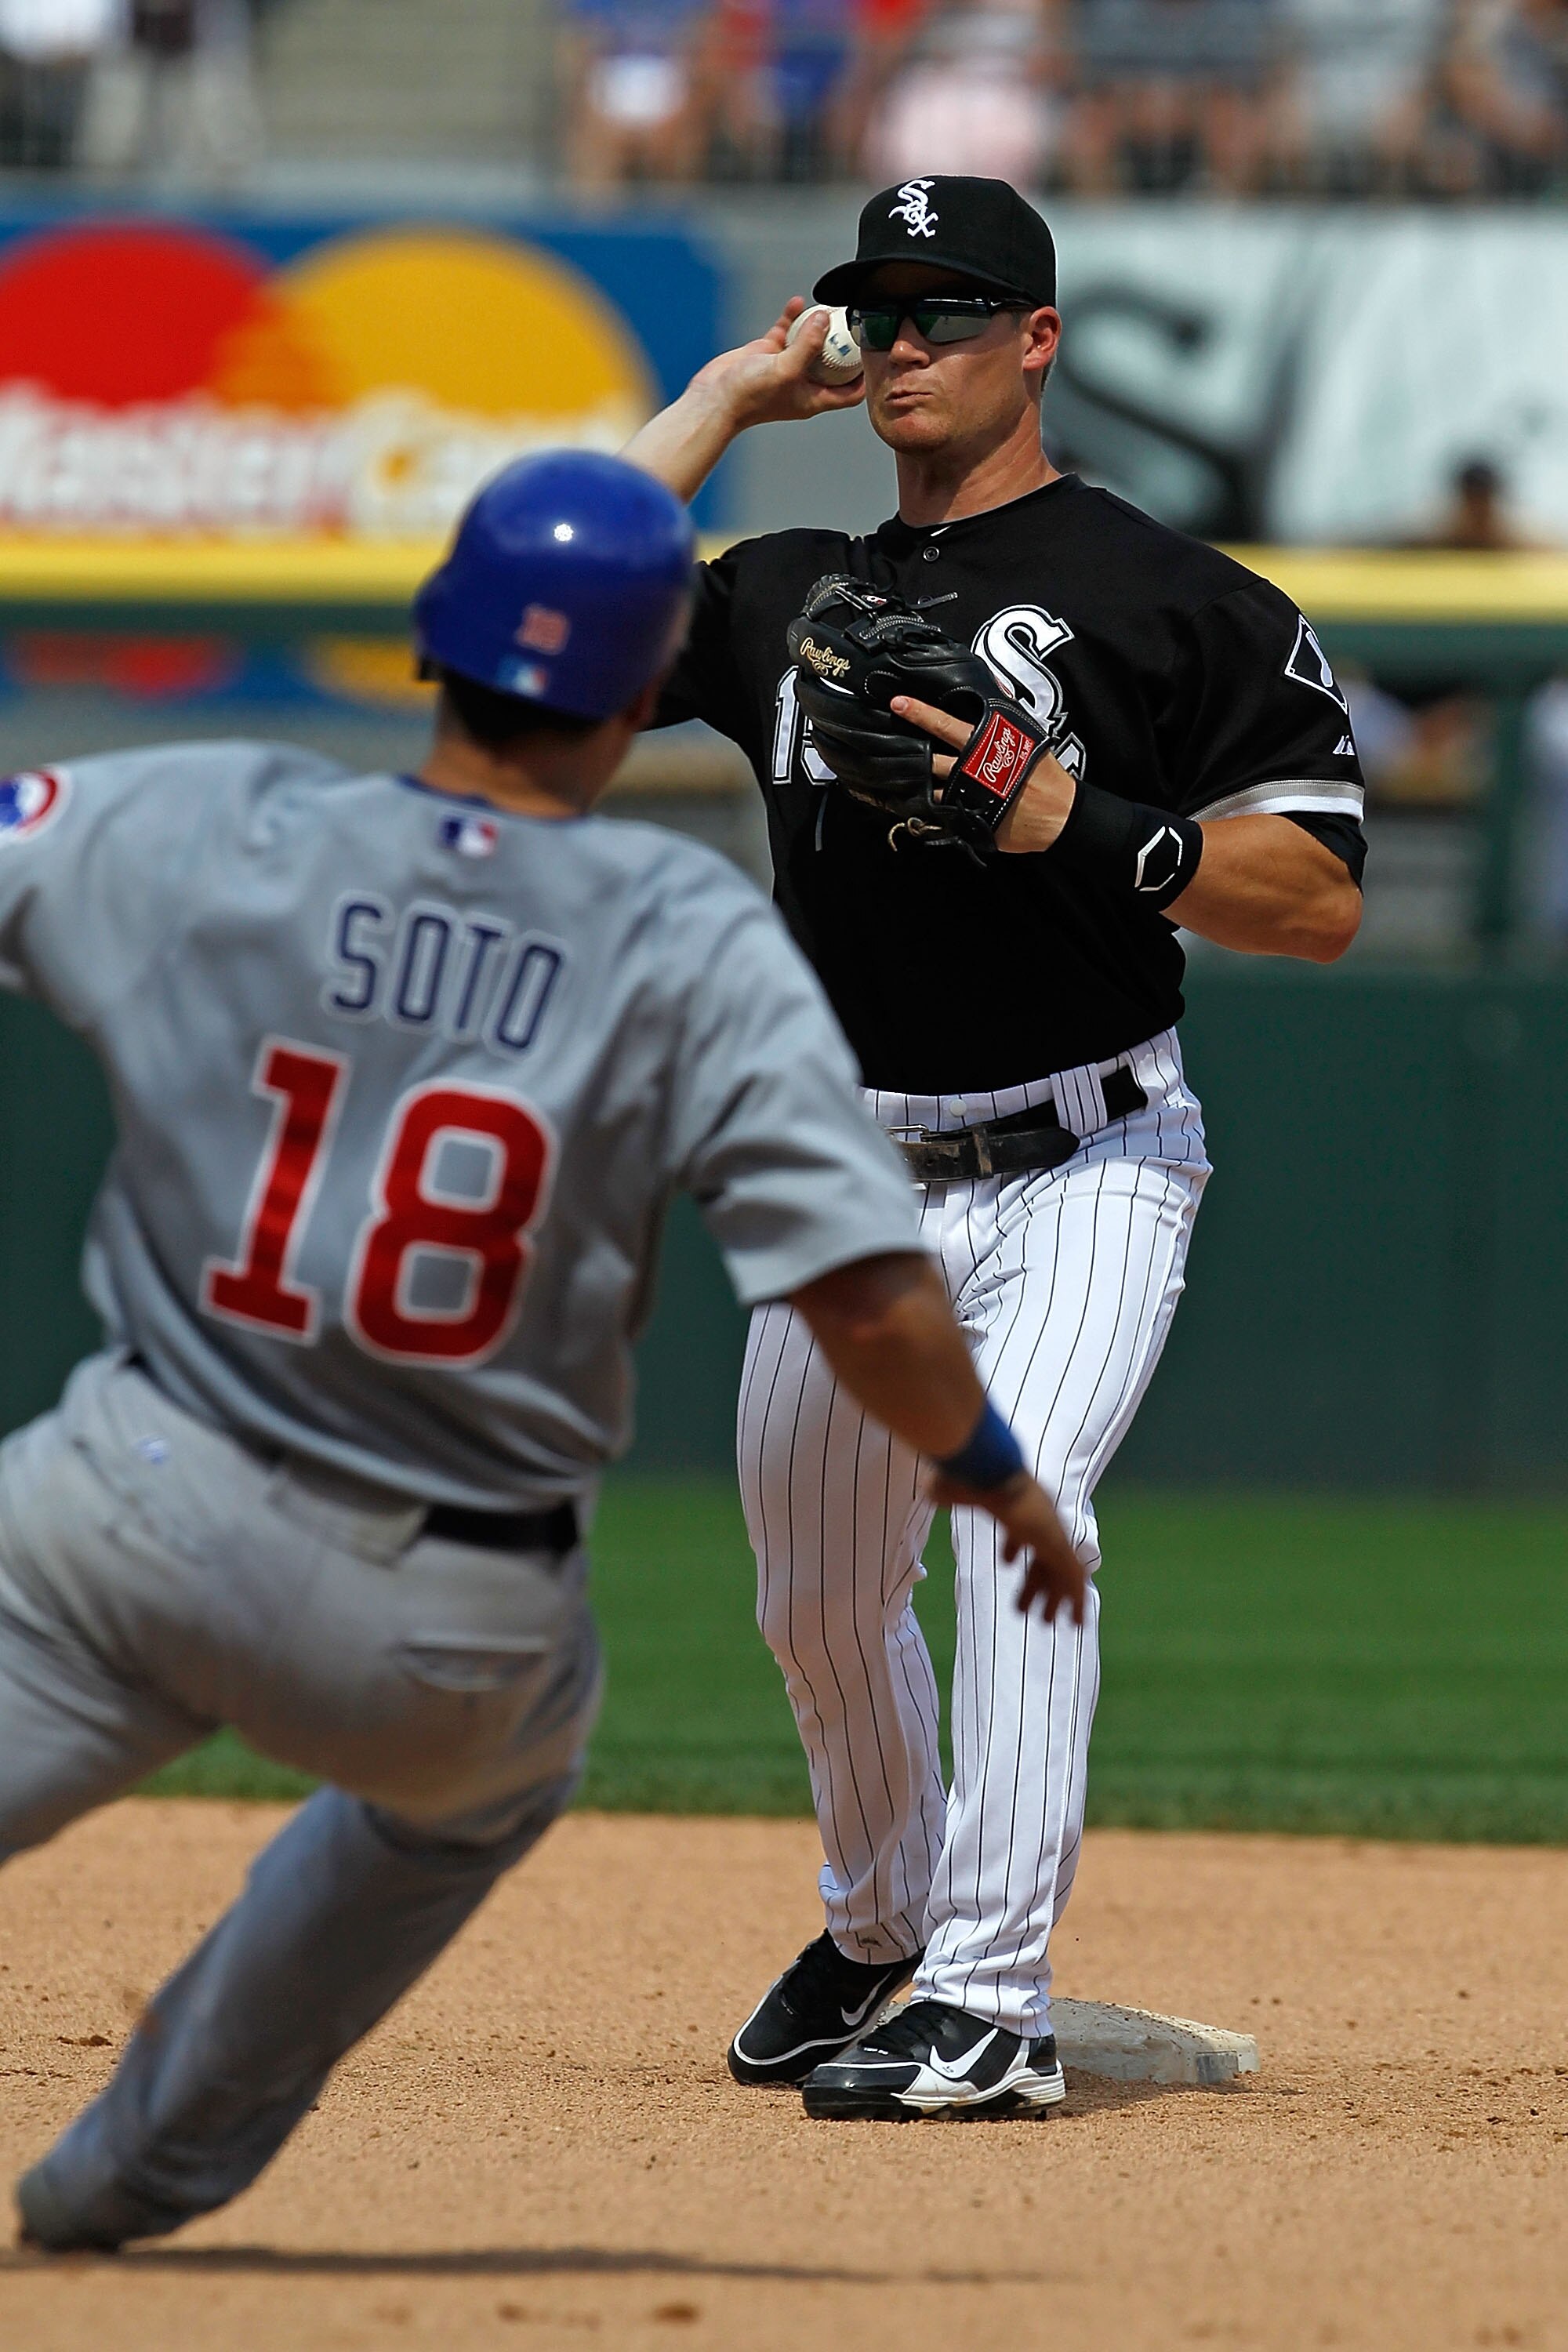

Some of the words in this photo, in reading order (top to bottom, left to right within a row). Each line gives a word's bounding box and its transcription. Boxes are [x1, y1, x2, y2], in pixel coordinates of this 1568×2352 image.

[800, 637, 851, 677] Rawlings
[982, 726, 1017, 783] Rawlings
[330, 900, 566, 1054] SOTO
[199, 1035, 558, 1369] 18
